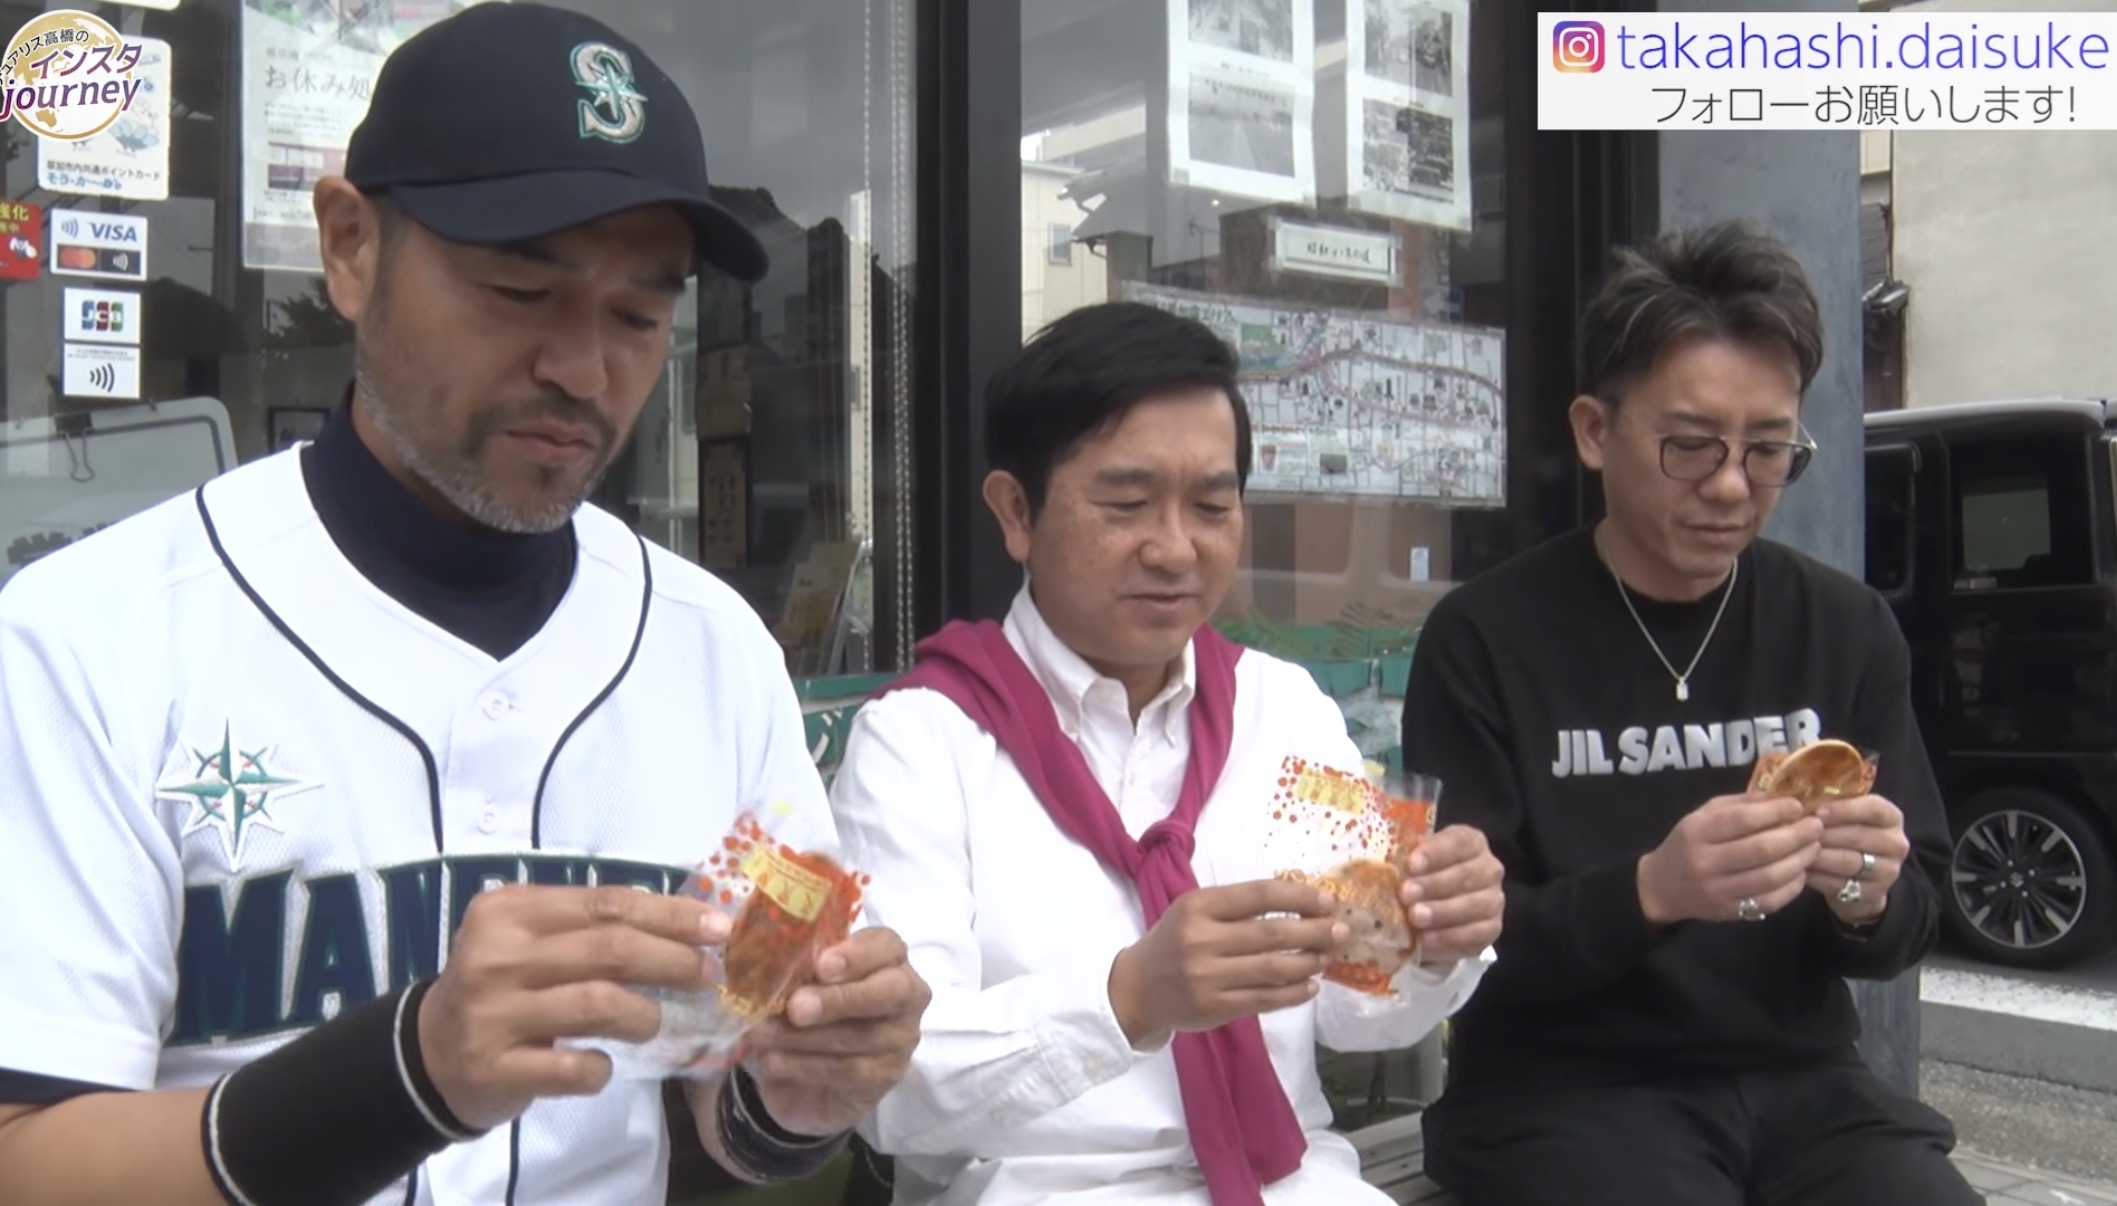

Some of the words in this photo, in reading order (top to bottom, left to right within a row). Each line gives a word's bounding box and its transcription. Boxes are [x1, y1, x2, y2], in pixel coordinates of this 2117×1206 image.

[264, 64, 371, 102] お休み処
[87, 221, 138, 242] VISA
[81, 300, 125, 332] JCB
[1552, 729, 1614, 778] JIL
[1618, 707, 1822, 776] SANDER
